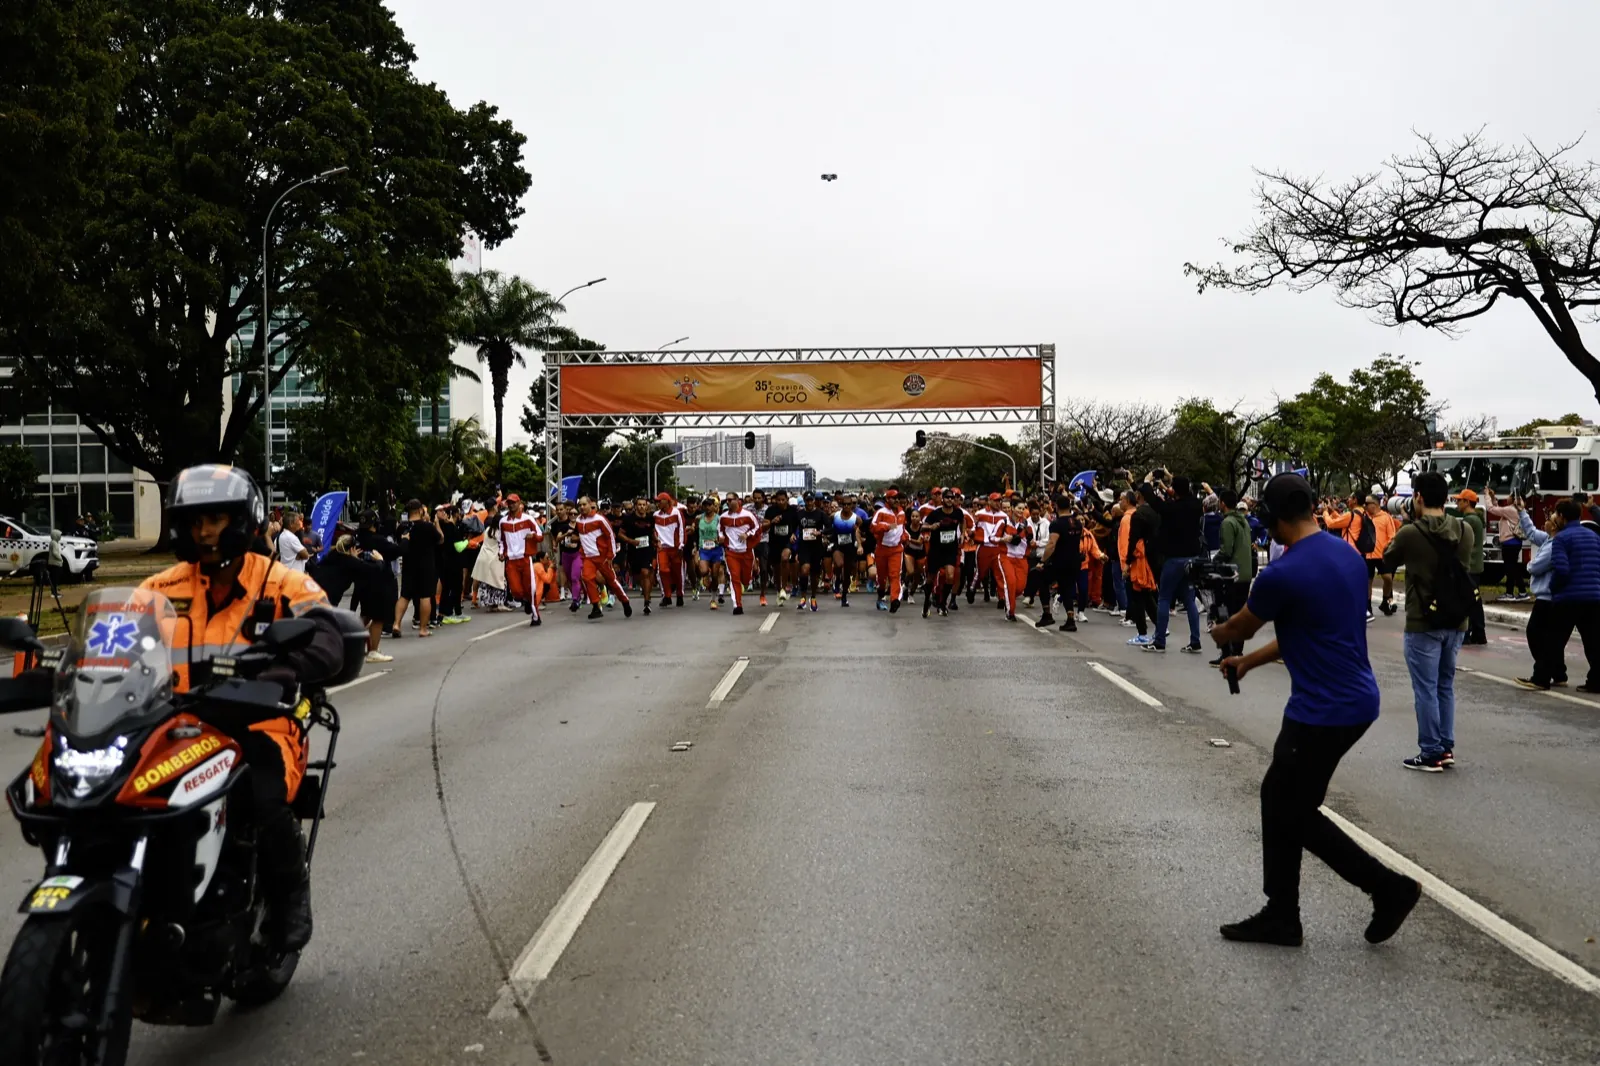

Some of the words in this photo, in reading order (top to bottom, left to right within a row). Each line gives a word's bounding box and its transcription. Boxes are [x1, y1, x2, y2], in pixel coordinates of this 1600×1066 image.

[766, 391, 808, 404] FOGO
[319, 499, 334, 526] saúde
[133, 735, 221, 793] BOMBEIROS
[183, 756, 232, 793] RESGATE
